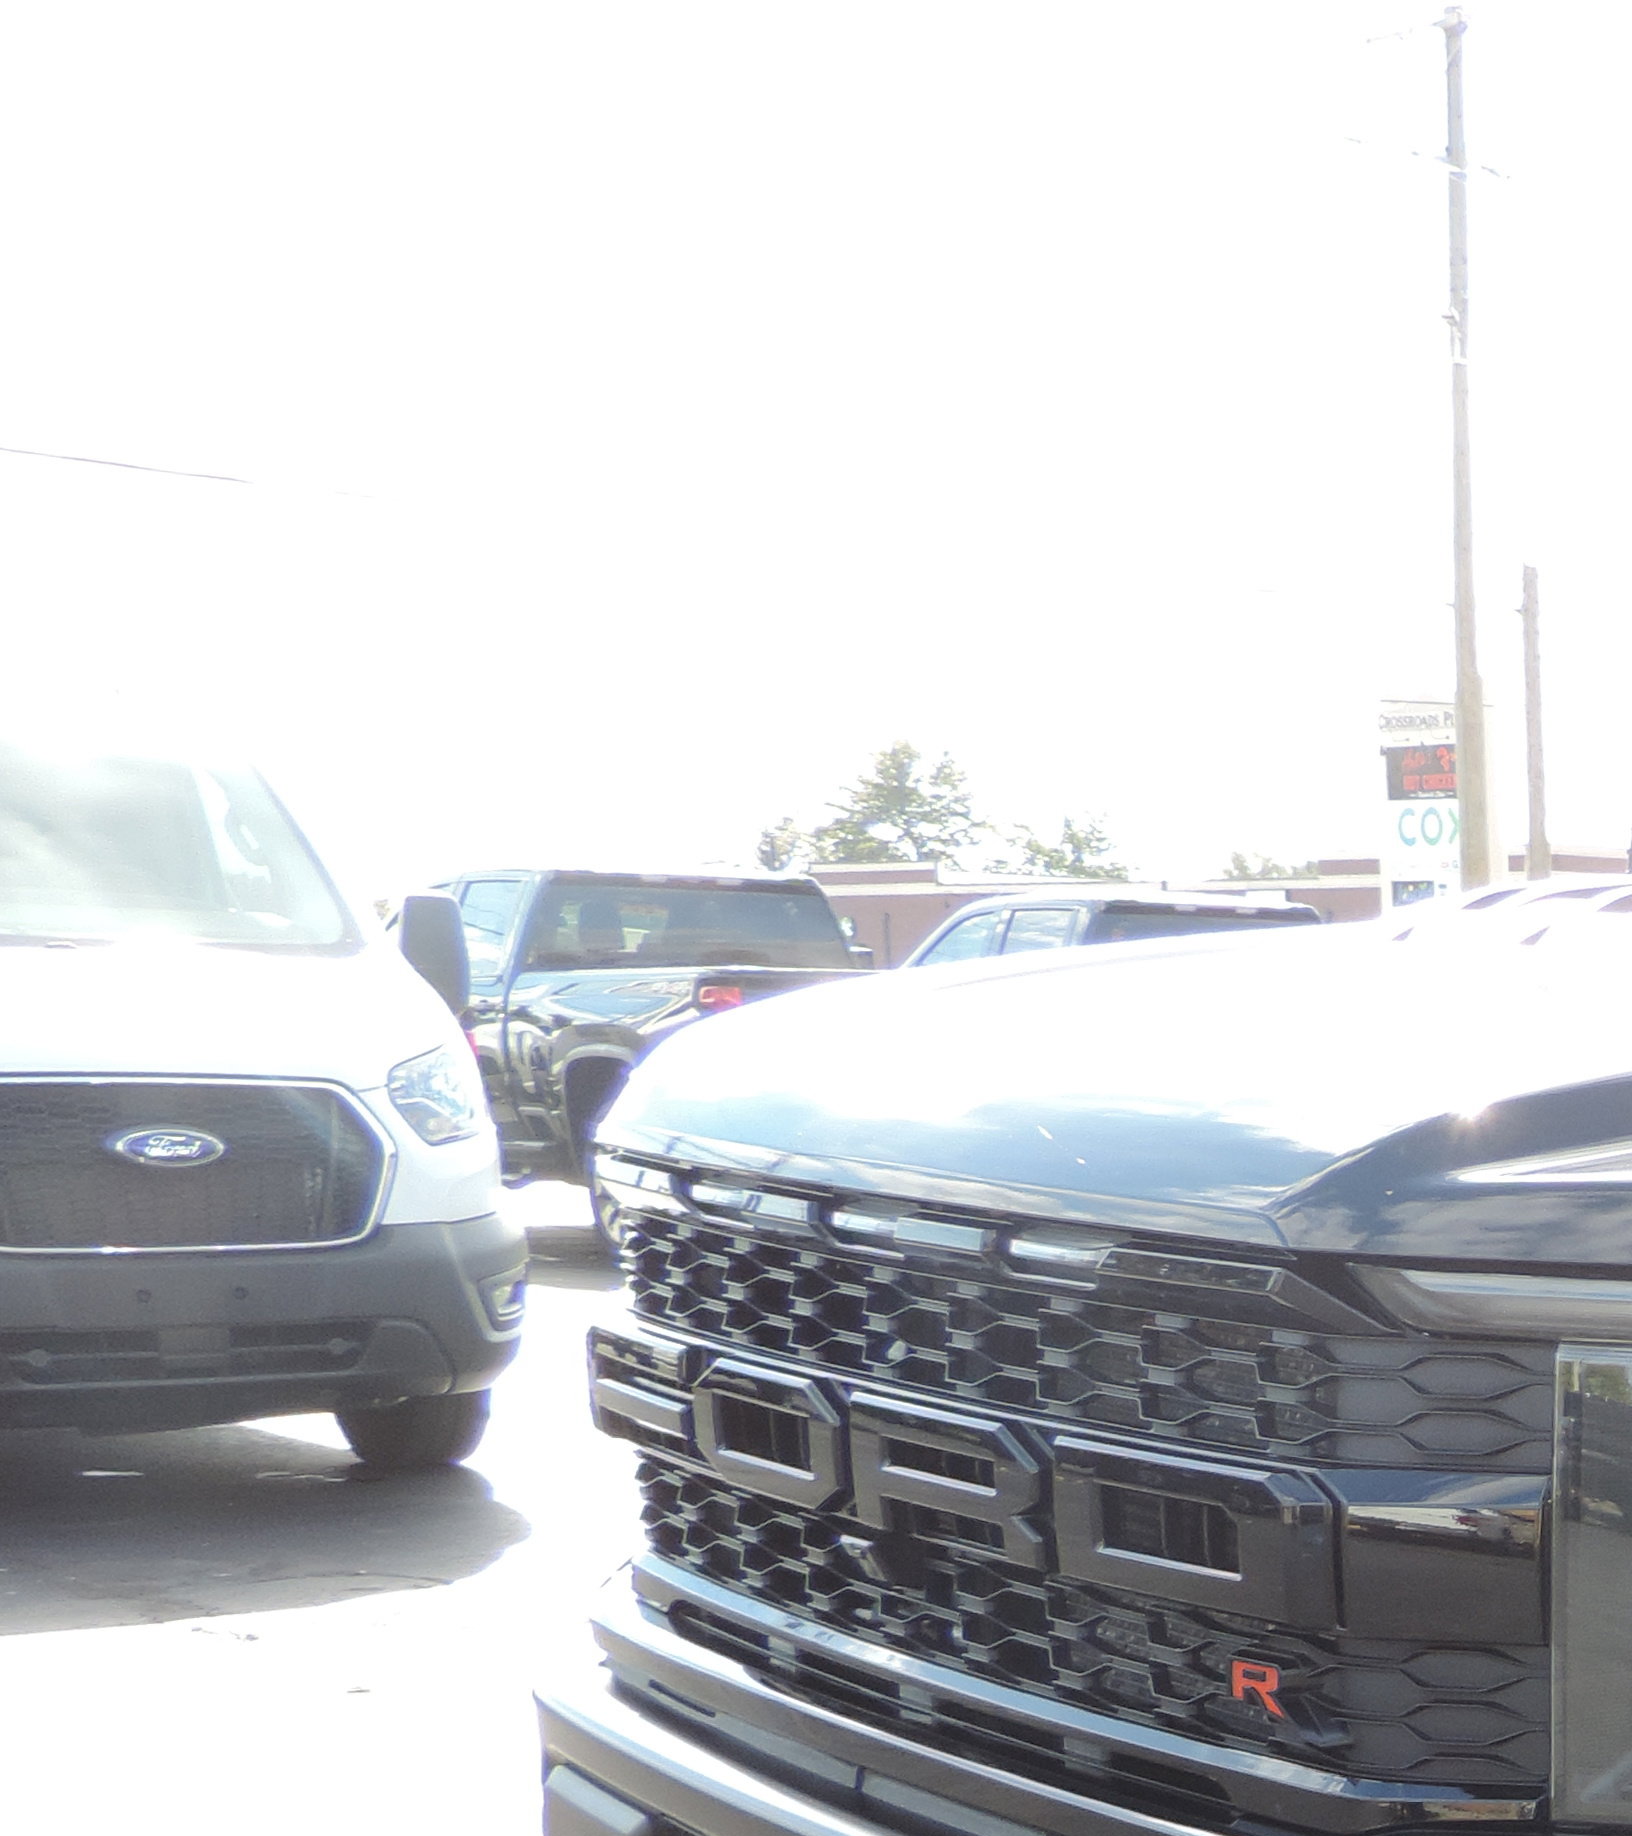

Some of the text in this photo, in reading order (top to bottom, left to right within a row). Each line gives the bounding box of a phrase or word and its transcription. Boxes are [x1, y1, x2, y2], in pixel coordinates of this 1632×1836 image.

[143, 1134, 203, 1159] Ford
[586, 1324, 1346, 1634] FORD
[1231, 1660, 1283, 1718] R
